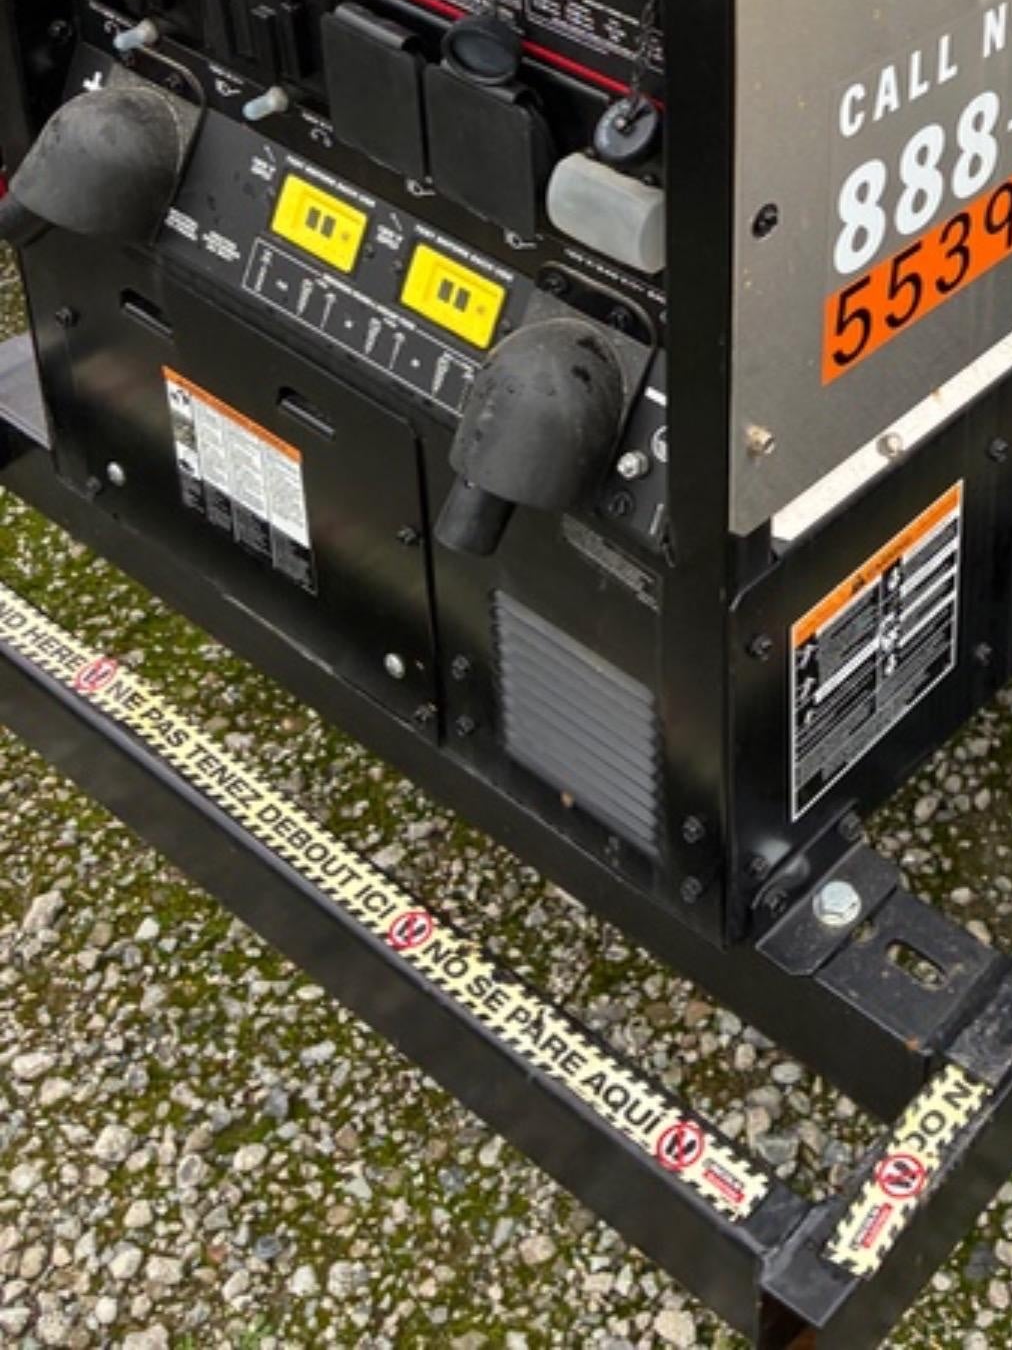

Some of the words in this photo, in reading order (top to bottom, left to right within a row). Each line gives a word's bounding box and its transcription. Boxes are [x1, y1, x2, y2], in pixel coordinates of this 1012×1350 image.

[839, 34, 958, 138] CALL
[25, 626, 88, 673] HERE
[105, 680, 147, 712] NE
[141, 708, 191, 749] PAS
[187, 743, 264, 810] TENEZ
[257, 803, 363, 887] DEBOUT
[354, 884, 398, 919] ICI
[423, 940, 469, 980] NO
[466, 973, 512, 1013] SE
[507, 1006, 588, 1077] PARE
